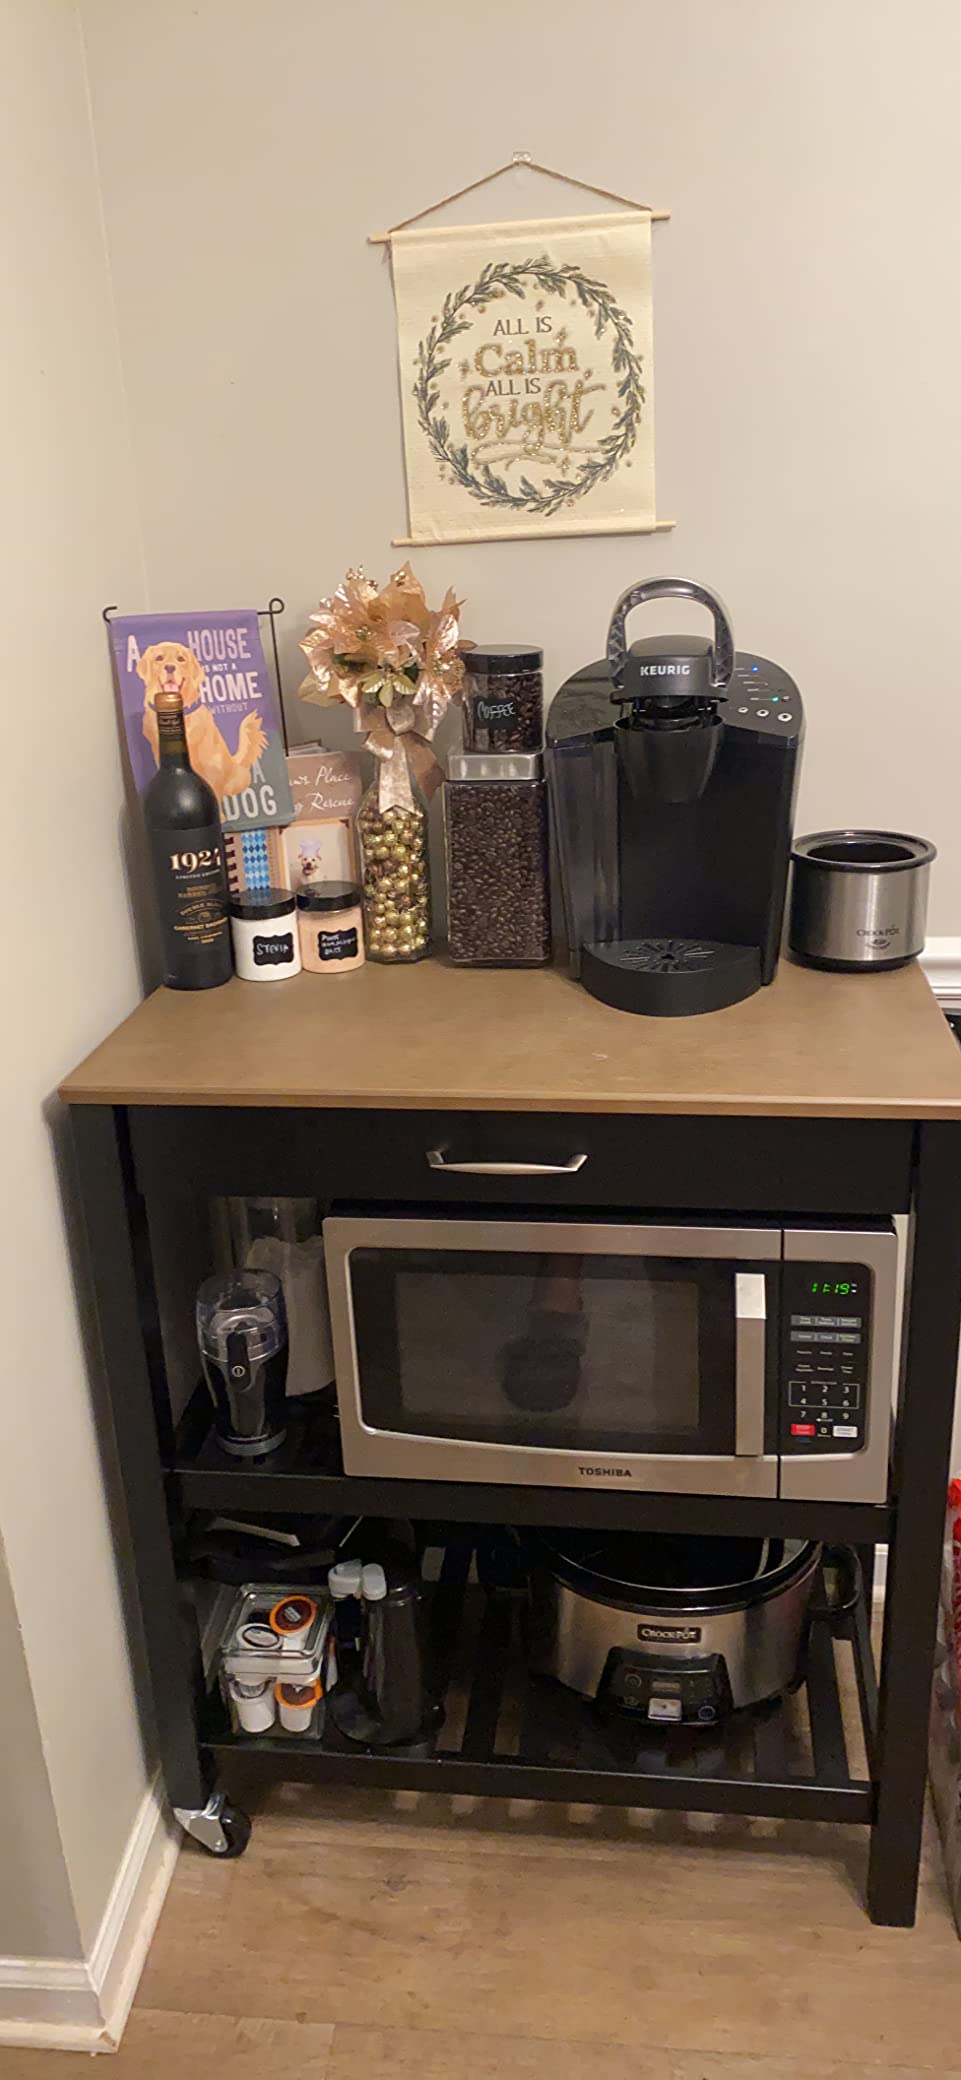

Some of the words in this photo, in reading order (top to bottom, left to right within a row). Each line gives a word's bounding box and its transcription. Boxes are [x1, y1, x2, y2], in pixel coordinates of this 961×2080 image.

[493, 318, 529, 336] ALL
[536, 316, 553, 333] IS
[474, 338, 579, 377] Calm
[485, 379, 521, 397] ALL
[525, 377, 542, 394] IS
[462, 379, 607, 456] bright
[127, 635, 142, 672] A
[187, 628, 251, 661] HOUSE
[212, 663, 228, 672] NOT
[640, 665, 690, 676] KEURIG
[200, 672, 262, 703] HOME
[208, 702, 249, 714] WITHOUT
[252, 762, 266, 784] A
[315, 766, 351, 786] Place
[223, 785, 277, 821] DOG
[822, 1385, 829, 1393] 2
[843, 1386, 850, 1394] 3
[821, 1398, 828, 1406] 5
[800, 1410, 807, 1418] 7
[821, 1411, 828, 1419] 8
[842, 1412, 850, 1420] 9
[578, 1466, 632, 1477] TOSHIBA
